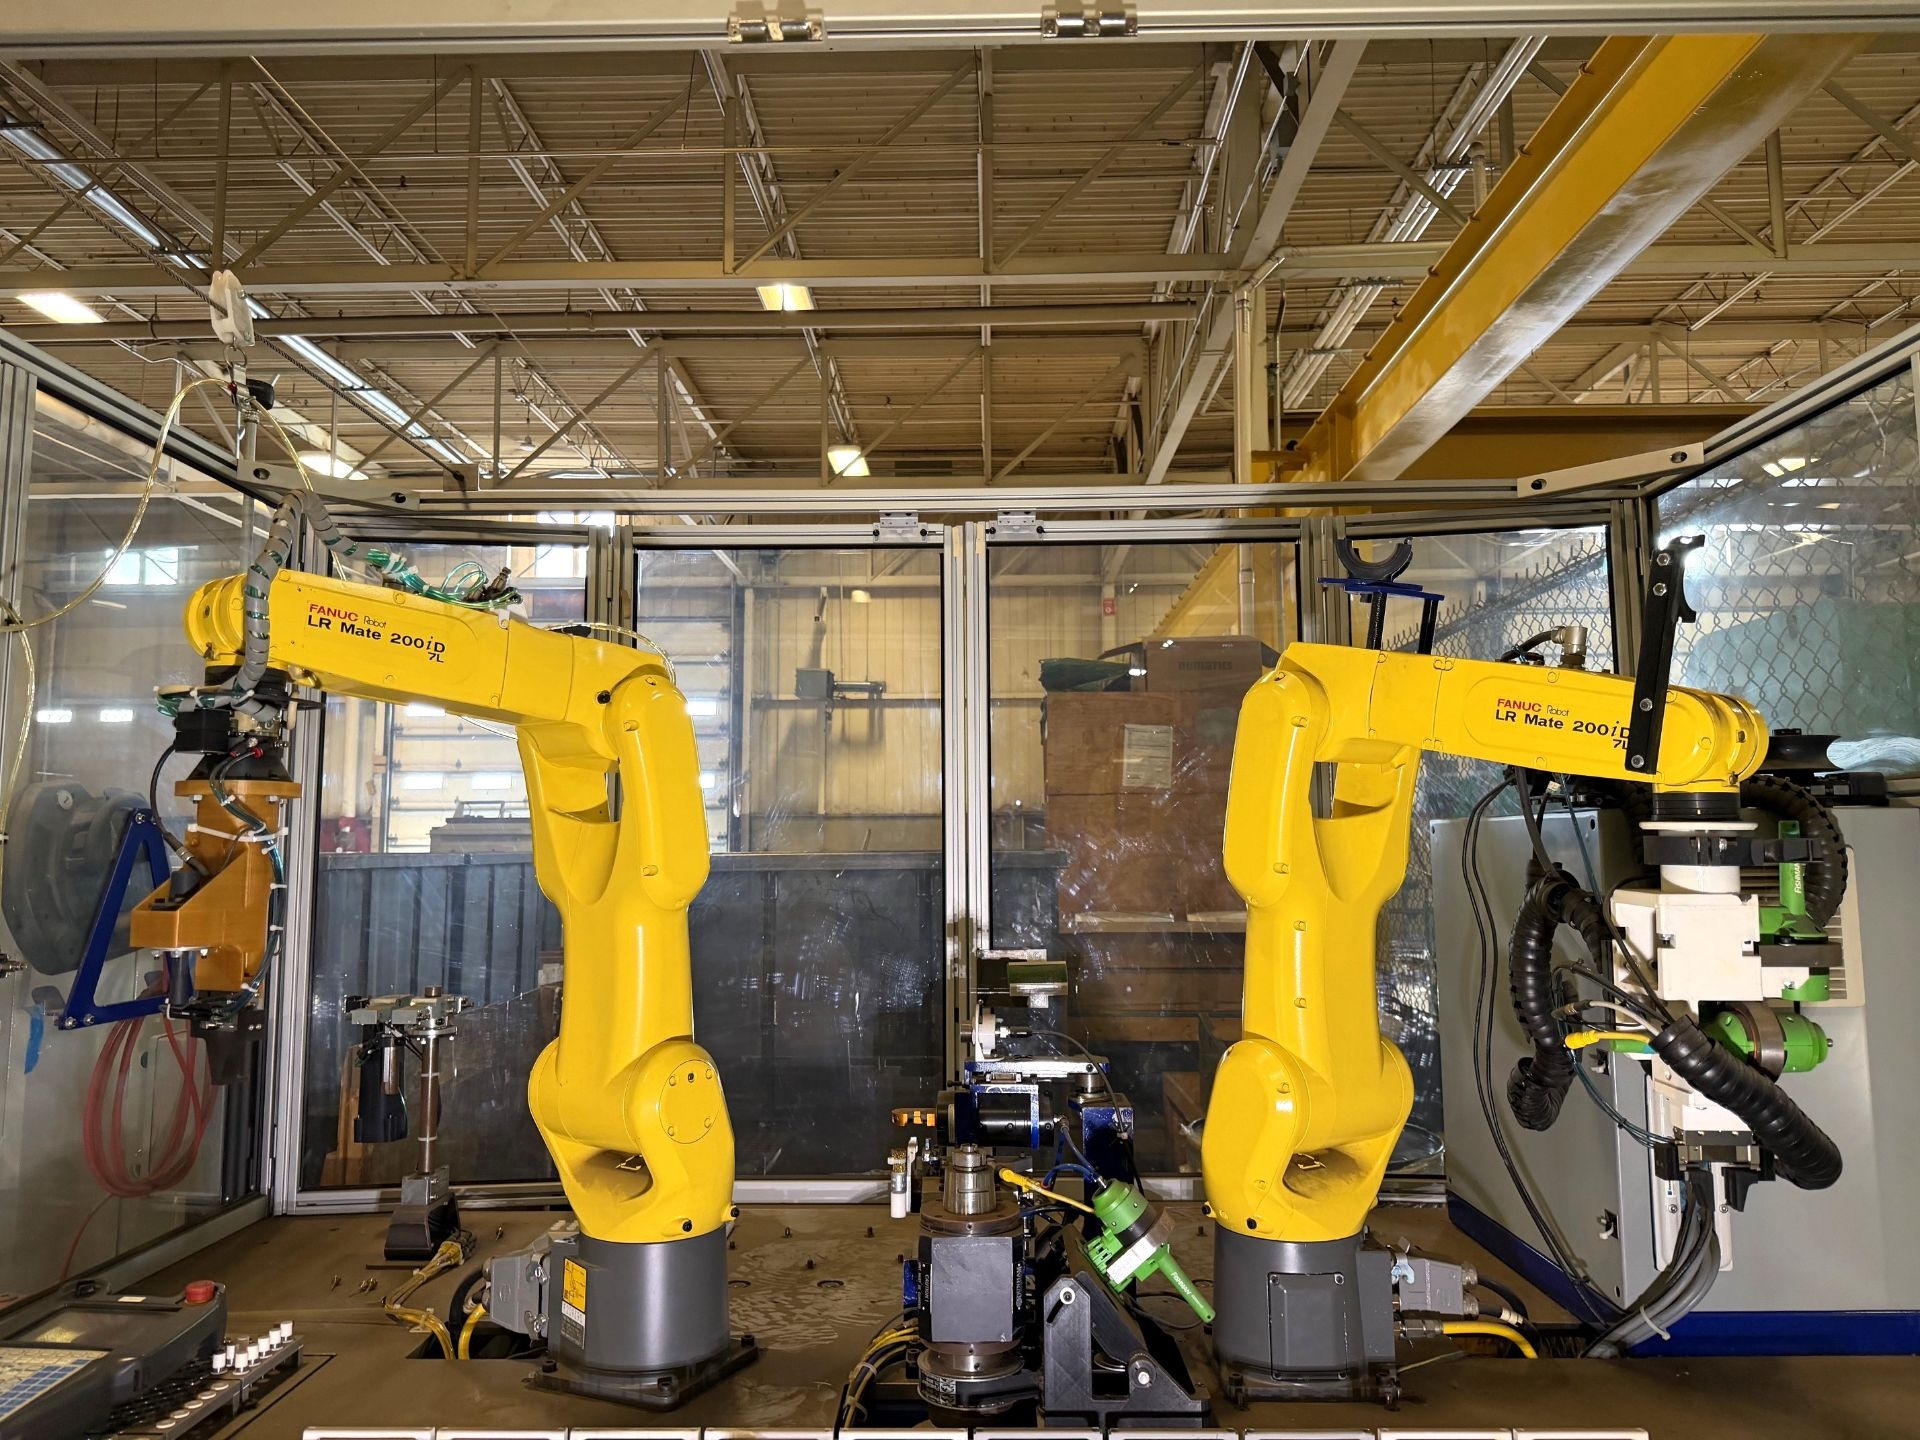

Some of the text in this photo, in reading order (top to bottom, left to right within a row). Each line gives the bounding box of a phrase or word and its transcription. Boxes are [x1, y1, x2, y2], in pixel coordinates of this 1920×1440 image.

[309, 603, 387, 629] FANUC Robot
[307, 614, 446, 654] LR Mate 200iD
[427, 651, 444, 663] 7L
[1497, 698, 1569, 717] FANUC Robot
[1495, 709, 1517, 722] LR
[1524, 713, 1564, 730] Mate
[1171, 1271, 1192, 1295] FISHMAN
